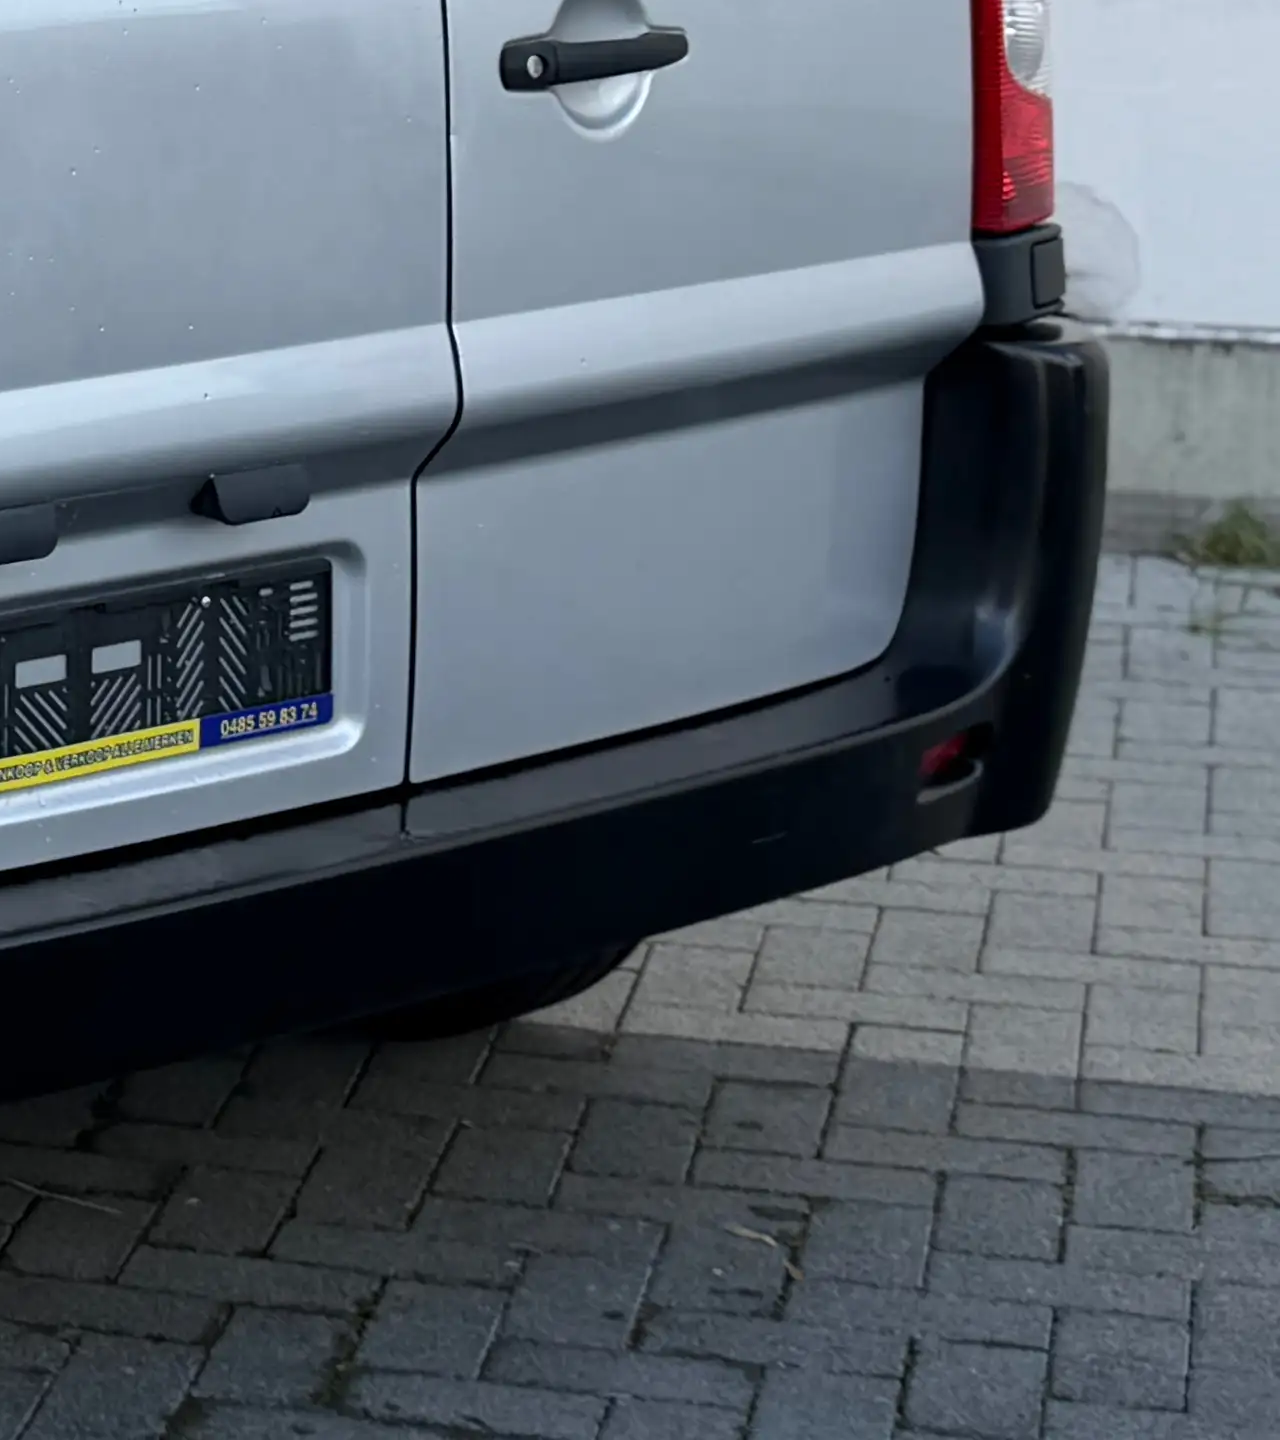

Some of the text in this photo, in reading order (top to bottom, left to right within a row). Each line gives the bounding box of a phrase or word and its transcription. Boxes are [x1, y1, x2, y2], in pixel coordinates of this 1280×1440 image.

[221, 702, 318, 737] 0485 59 83 74
[44, 759, 54, 775] &
[55, 744, 112, 772] VERKOOP
[143, 728, 194, 753] MERKEN
